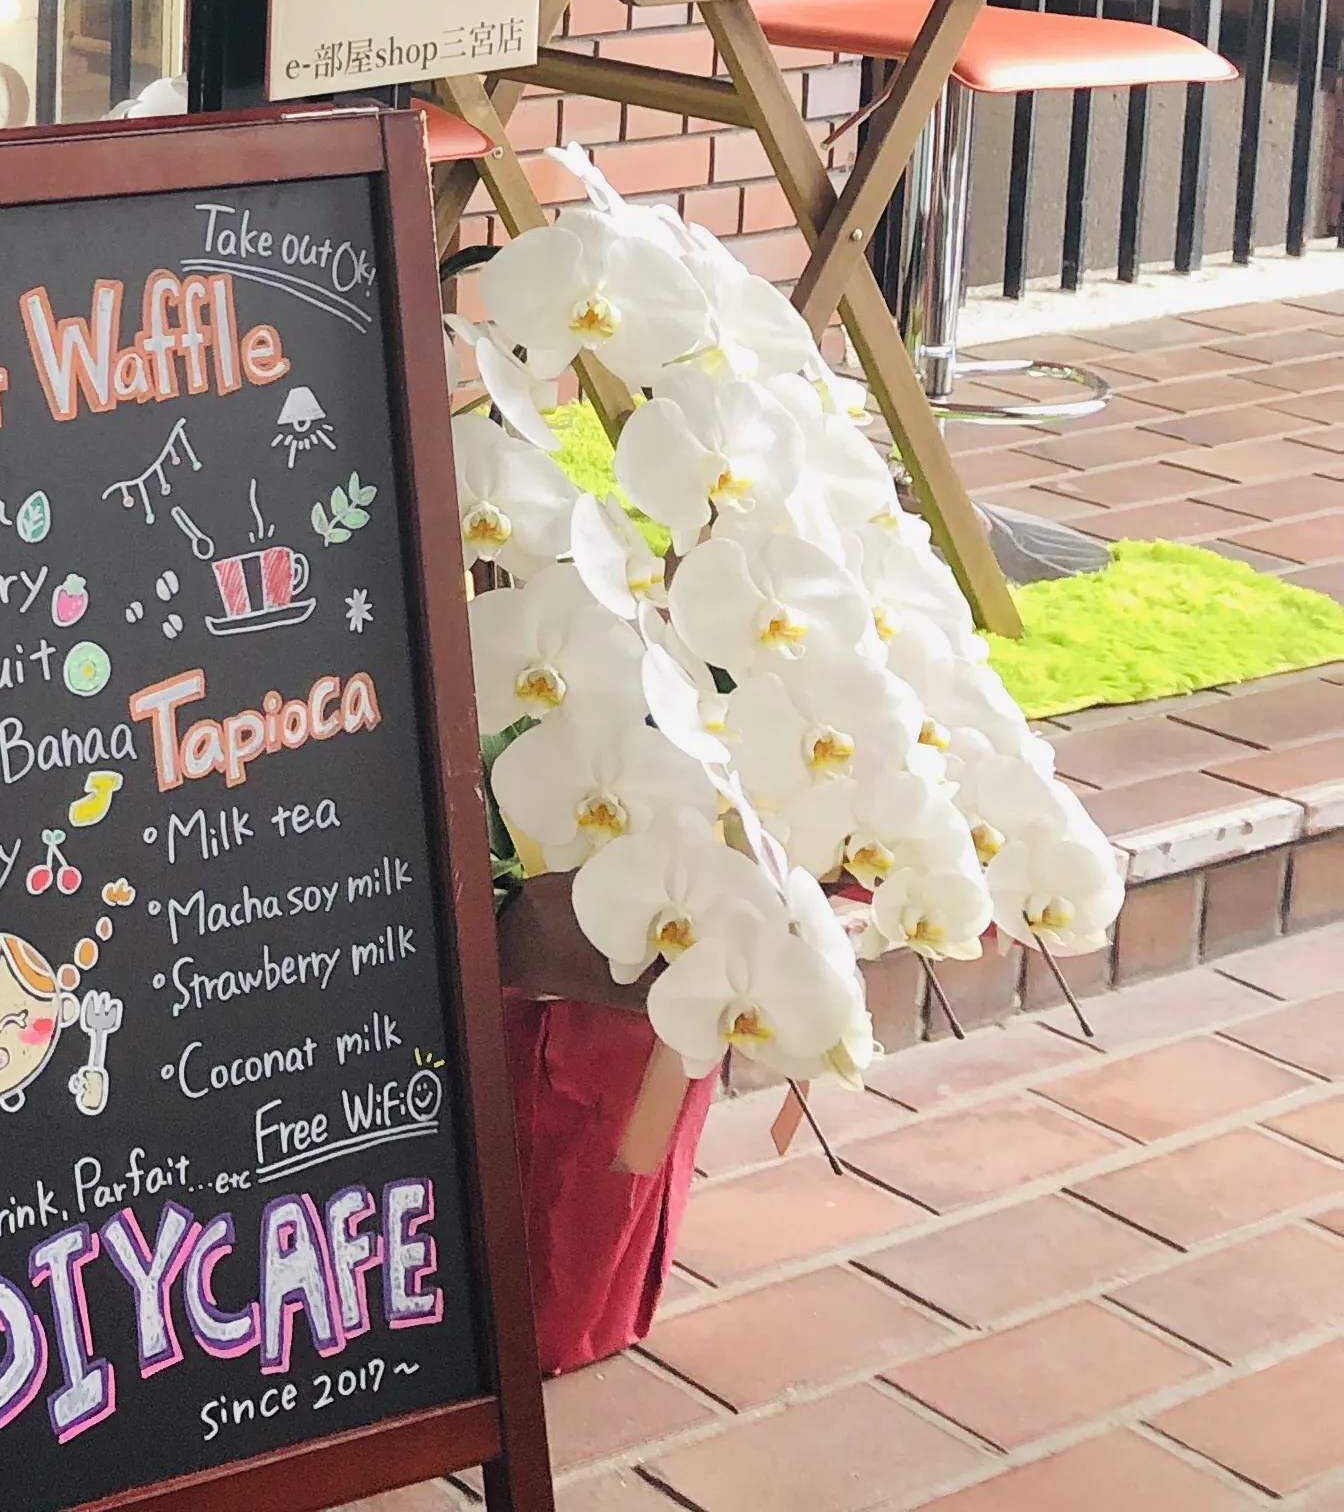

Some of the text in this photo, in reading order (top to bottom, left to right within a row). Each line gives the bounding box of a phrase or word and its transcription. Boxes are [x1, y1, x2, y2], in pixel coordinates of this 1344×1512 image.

[285, 17, 525, 80] e-部屋shop三宮店
[195, 204, 272, 258] Take
[282, 233, 332, 268] out
[19, 268, 290, 422] Waffle
[129, 668, 382, 792] Tapioca
[165, 797, 340, 864] Milk tea
[168, 857, 414, 944] Macha soy milk
[171, 927, 417, 1018] Strawberry milk
[336, 1011, 403, 1065] milk
[255, 1099, 329, 1164] Free
[200, 1381, 297, 1442] since
